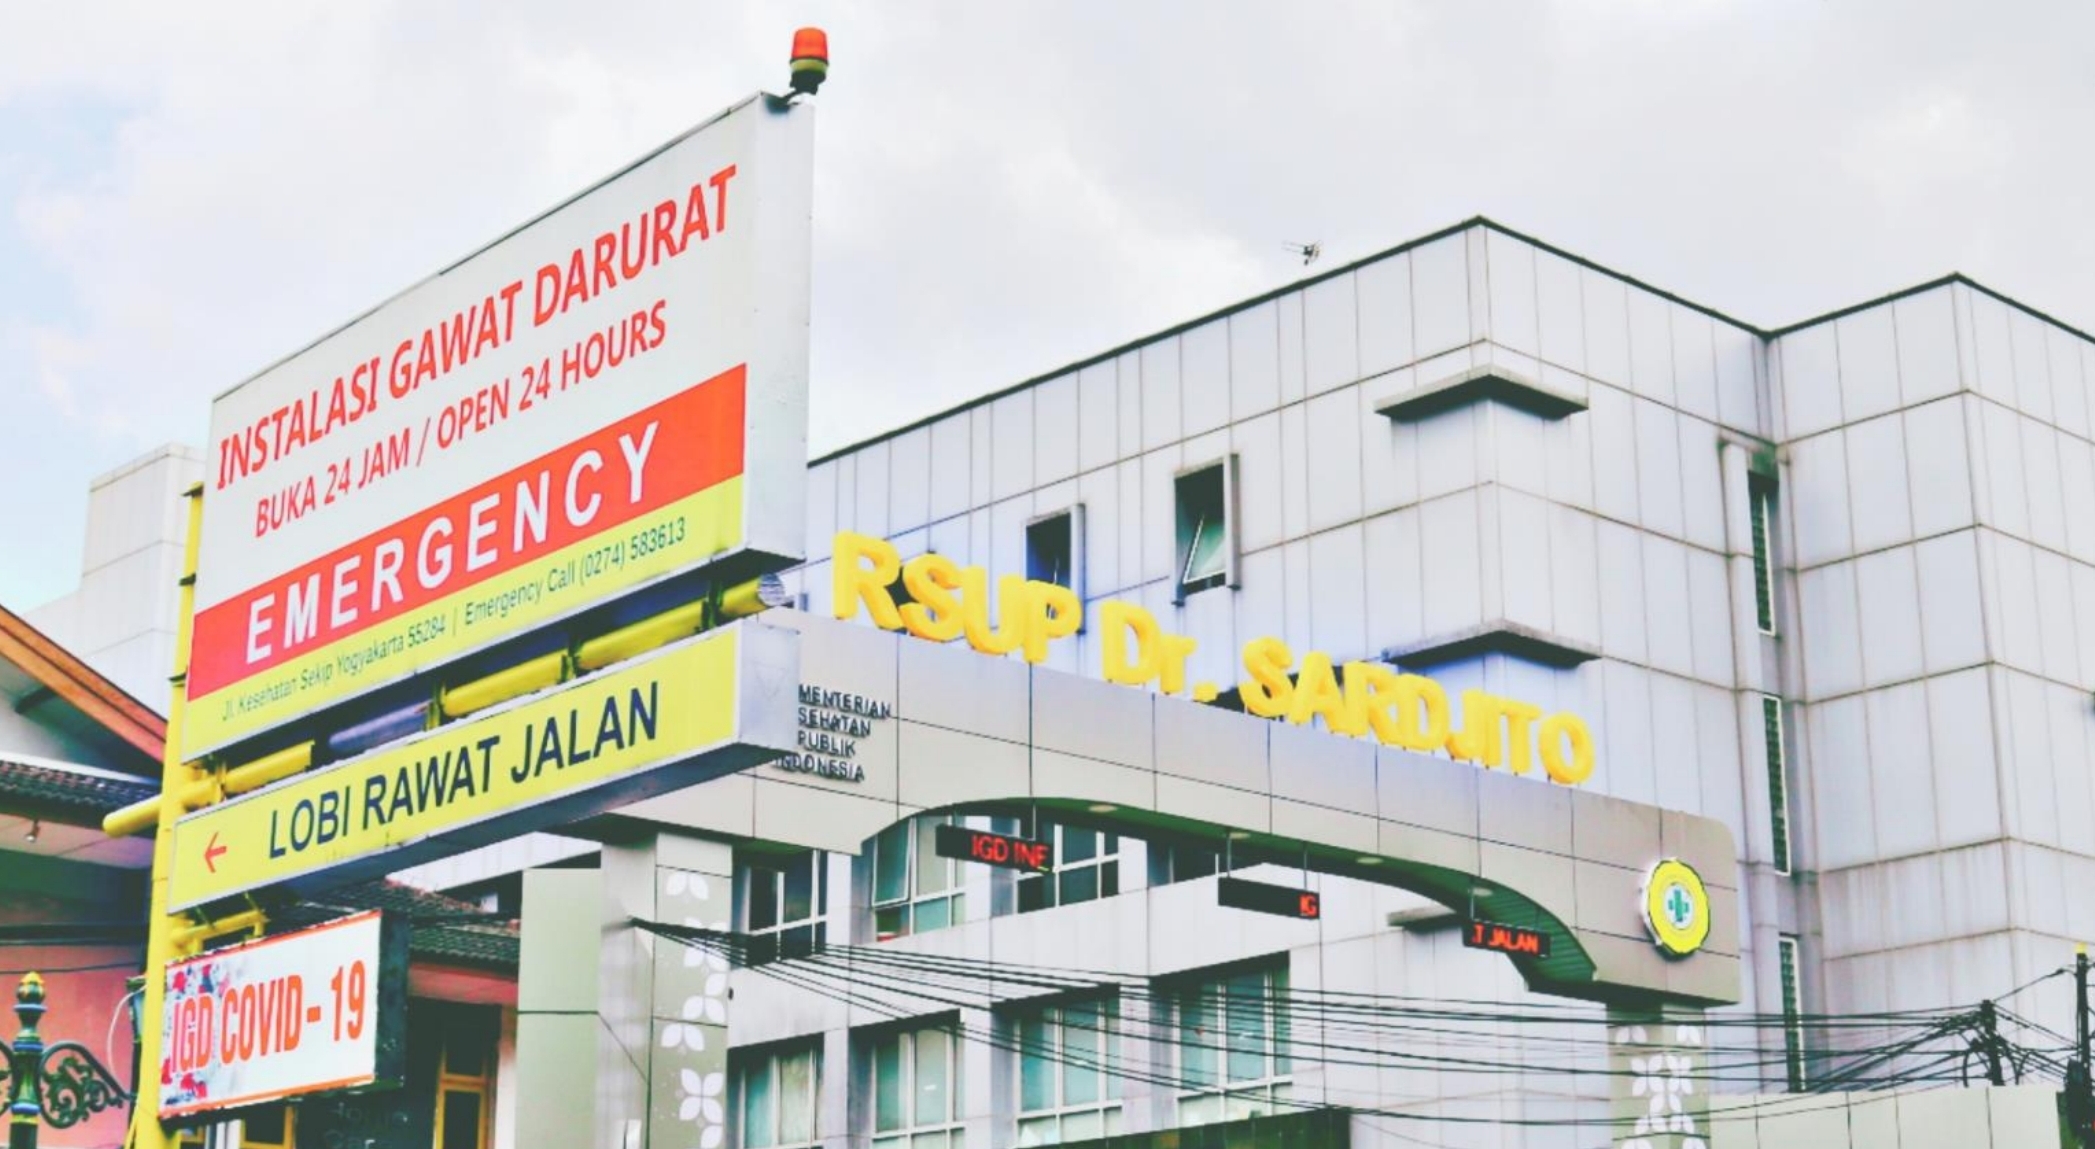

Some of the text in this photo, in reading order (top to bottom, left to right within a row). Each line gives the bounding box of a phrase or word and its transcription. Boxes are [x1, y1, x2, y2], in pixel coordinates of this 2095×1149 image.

[216, 164, 737, 491] INSTALASI GAWAT DARURAT
[255, 475, 317, 538] BUKA
[324, 462, 351, 506] 24
[358, 428, 411, 487] JAM
[437, 378, 510, 449] OPEN
[519, 358, 552, 412] 24
[560, 299, 668, 392] HOURS
[245, 420, 660, 665] EMERGENCY
[336, 633, 404, 677] Yogyakarta
[407, 614, 446, 649] 55284
[465, 577, 543, 626] Emergency
[548, 557, 576, 592] Call
[578, 540, 627, 587] (0274)
[630, 516, 685, 561] 583613
[832, 530, 1596, 785] RSUP Dr. SARDJITO
[268, 680, 660, 860] LOBI RAWAT JALAN
[971, 834, 1009, 863] IGD
[169, 995, 214, 1074] IGD
